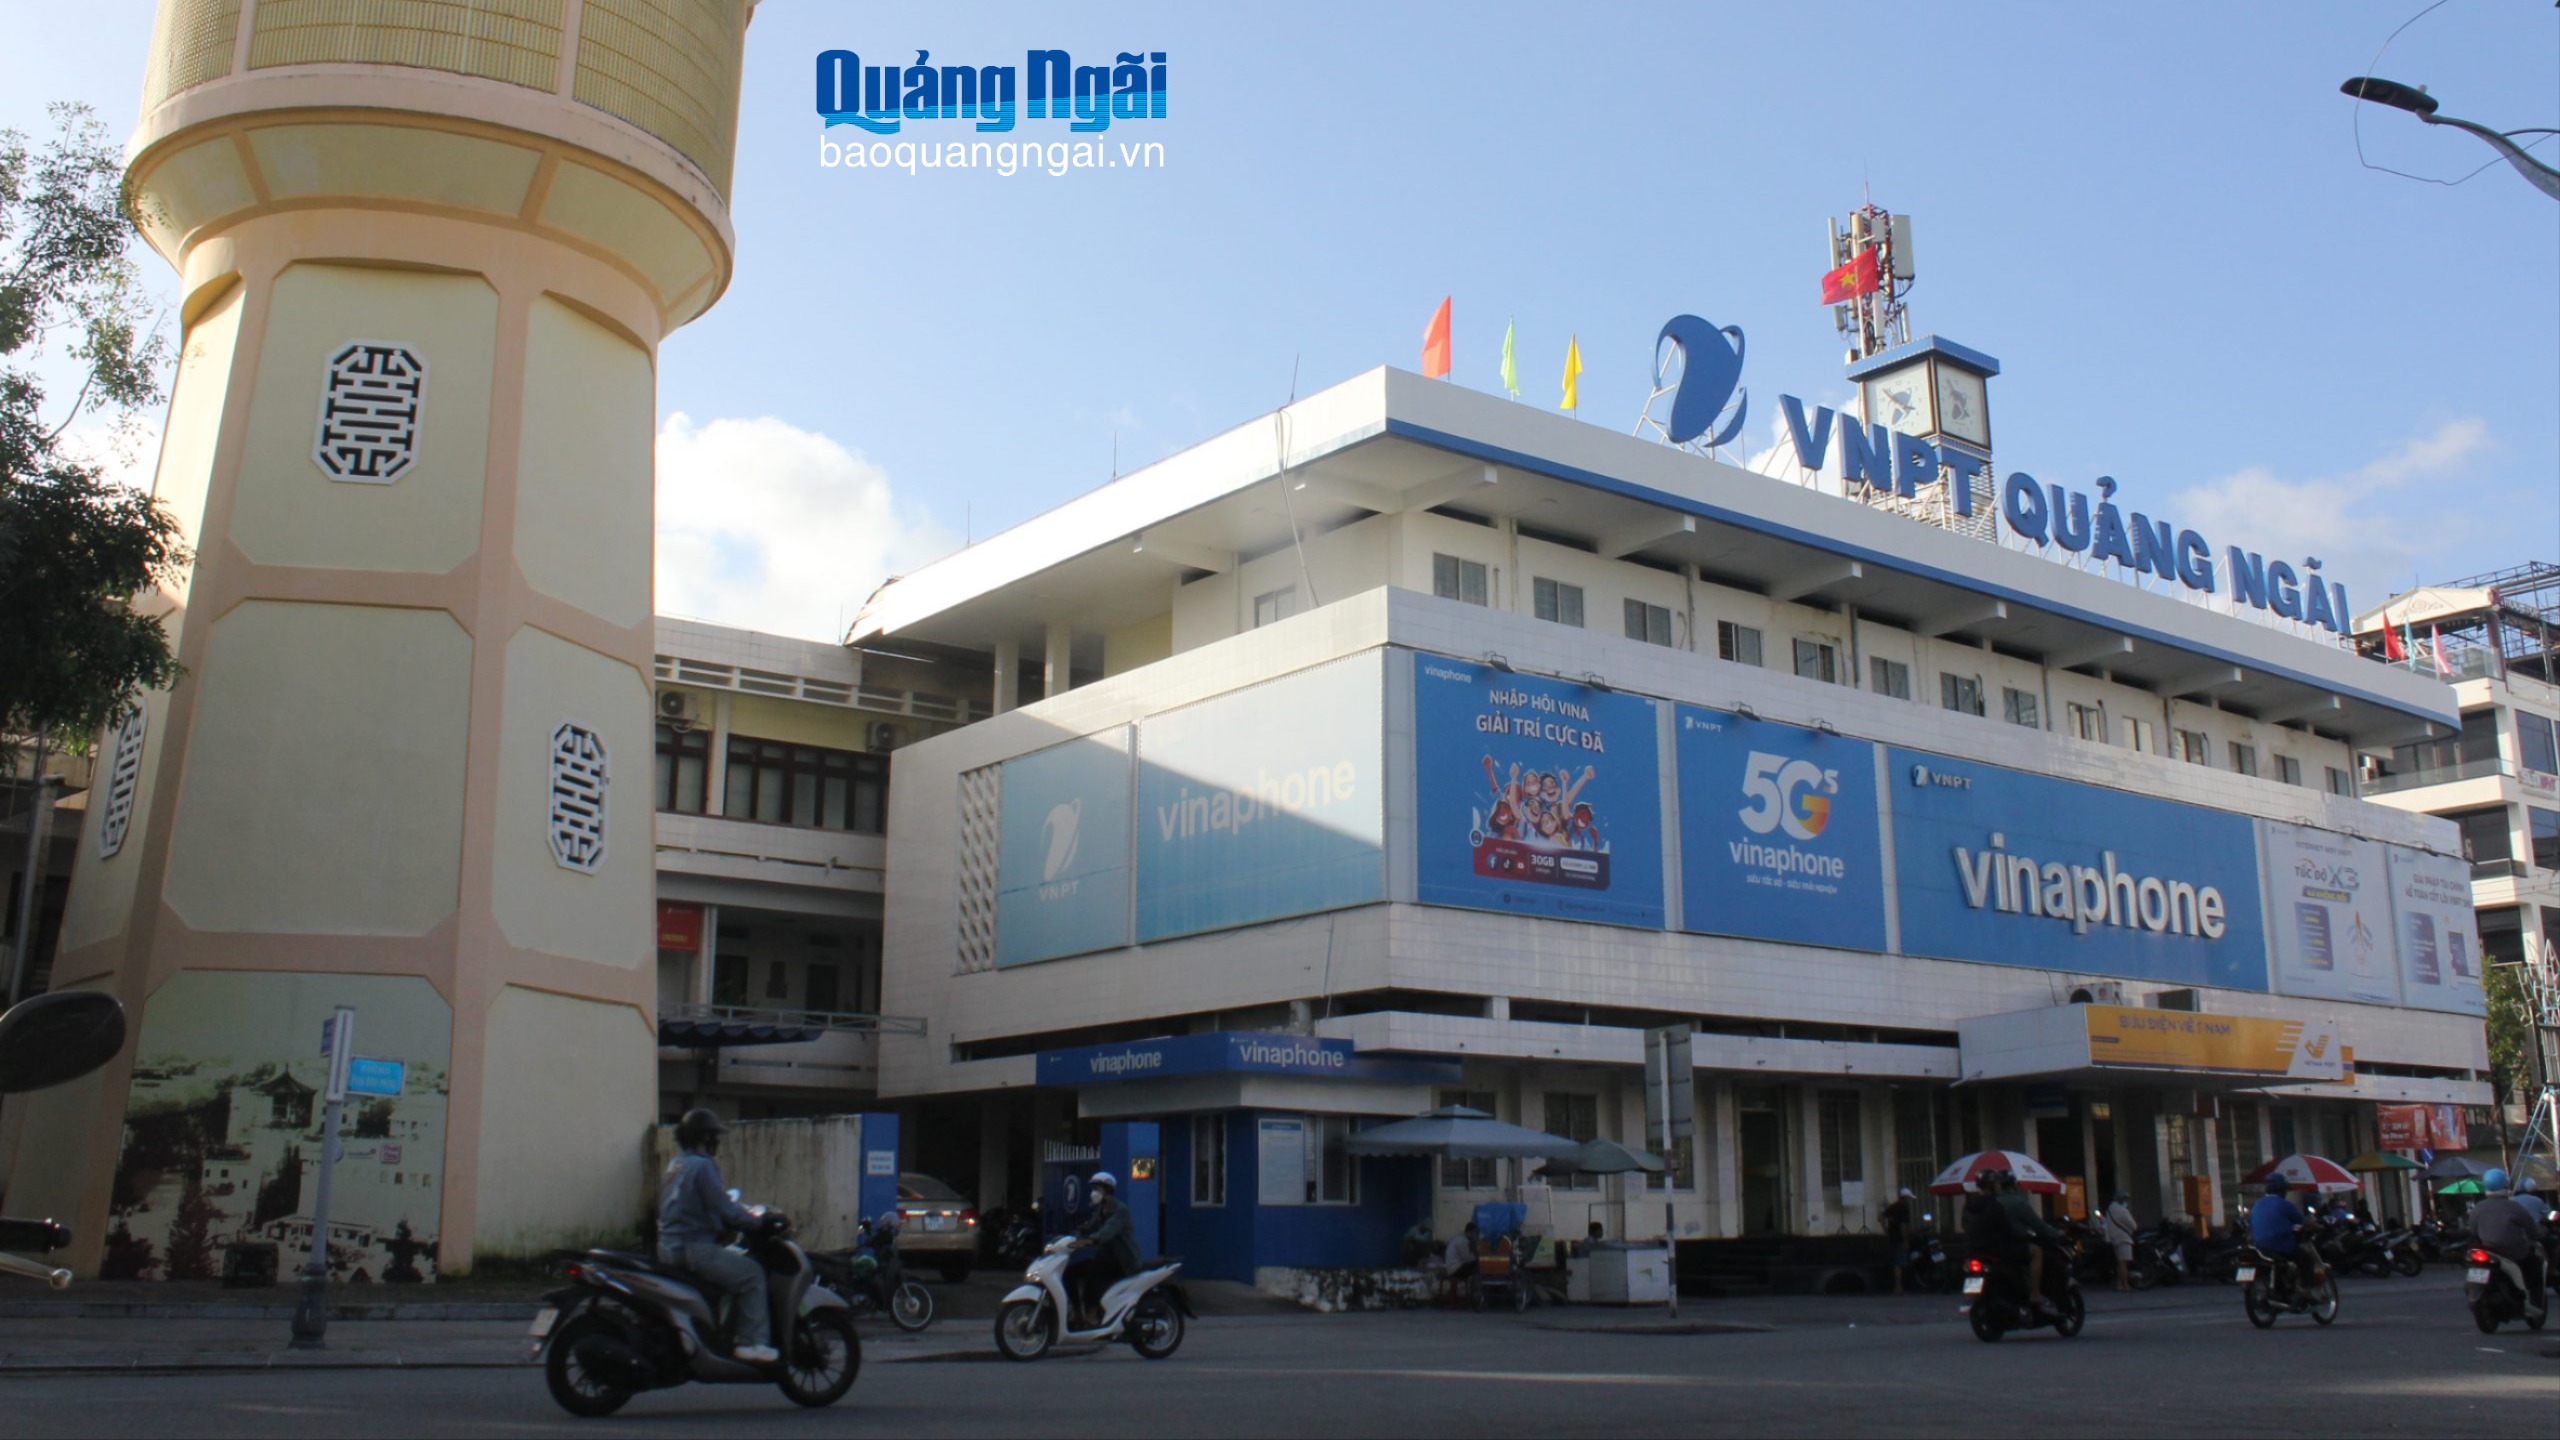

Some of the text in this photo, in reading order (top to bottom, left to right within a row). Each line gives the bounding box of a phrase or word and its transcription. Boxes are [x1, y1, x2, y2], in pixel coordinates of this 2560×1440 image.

[1779, 393, 2352, 638] VNPT QUẢNG NGÃI
[1424, 664, 1473, 684] vinaphone
[1489, 689, 1590, 723] NHẬP HỘI VINA
[1476, 710, 1605, 754] GIẢI TRÍ CỰC ĐÃ
[1931, 771, 1973, 790] VNPT
[1157, 759, 1357, 843] vinaphone
[1728, 836, 1845, 879] vinaphone
[1039, 880, 1080, 902] VNPT
[1953, 831, 2227, 940] vinaphone
[1090, 1048, 1162, 1075] vinaphone
[1239, 1040, 1345, 1068] vinaphone
